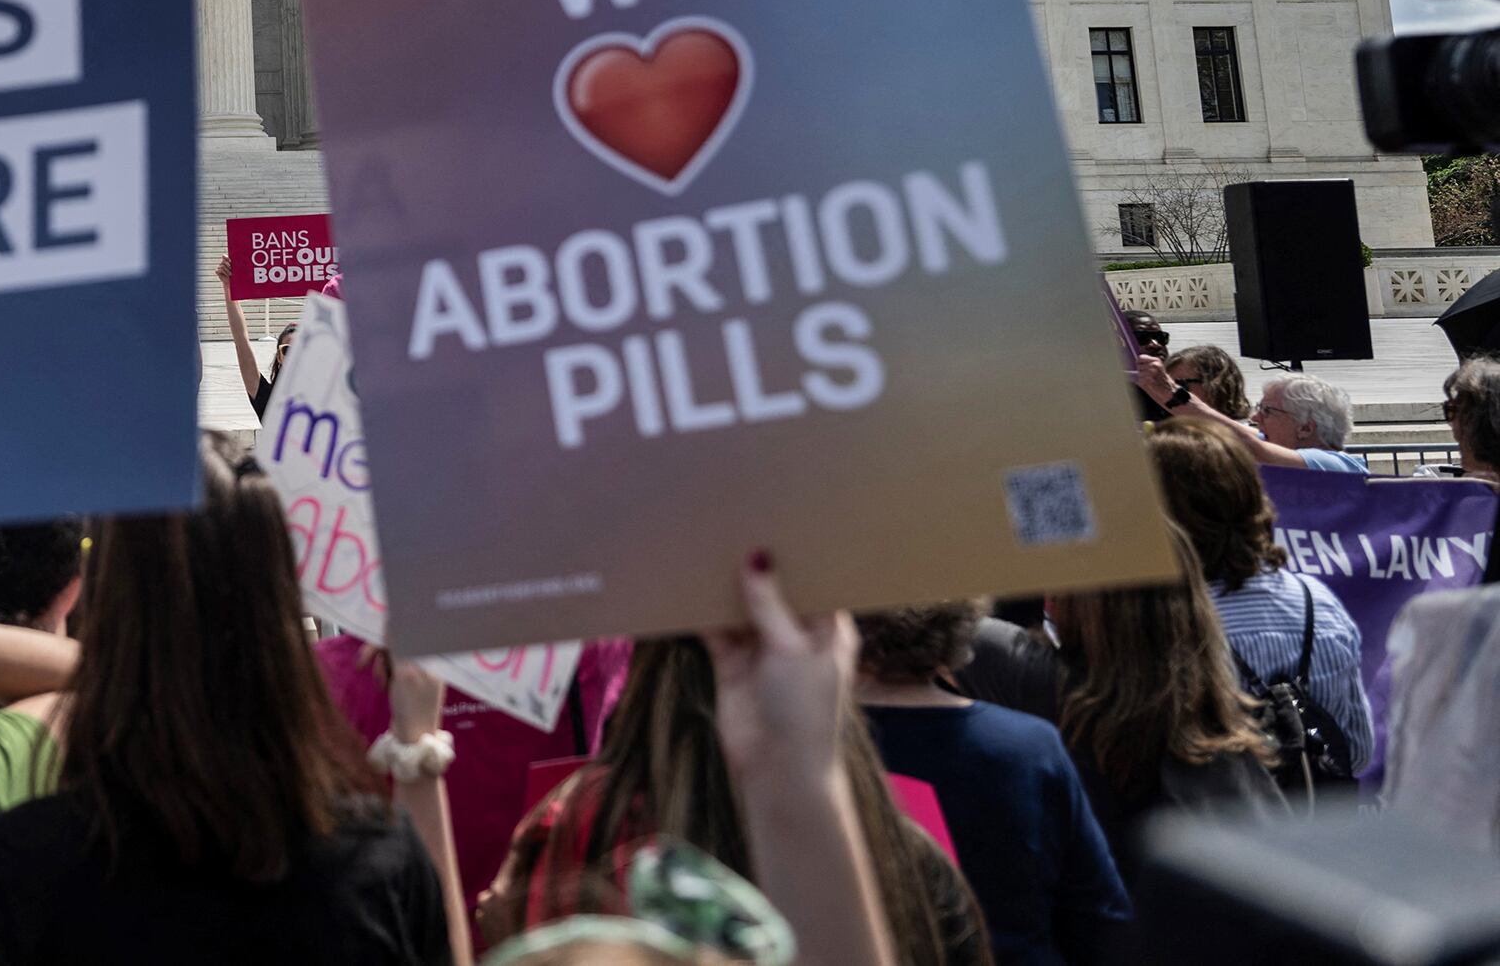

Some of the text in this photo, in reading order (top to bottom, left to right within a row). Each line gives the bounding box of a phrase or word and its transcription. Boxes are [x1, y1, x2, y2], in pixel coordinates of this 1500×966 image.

[251, 230, 310, 250] BANS
[251, 248, 294, 267] OFF
[253, 264, 340, 284] BODIES
[407, 160, 1009, 361] ABORTION
[543, 301, 886, 449] PILLS
[1357, 531, 1493, 580] LAWY
